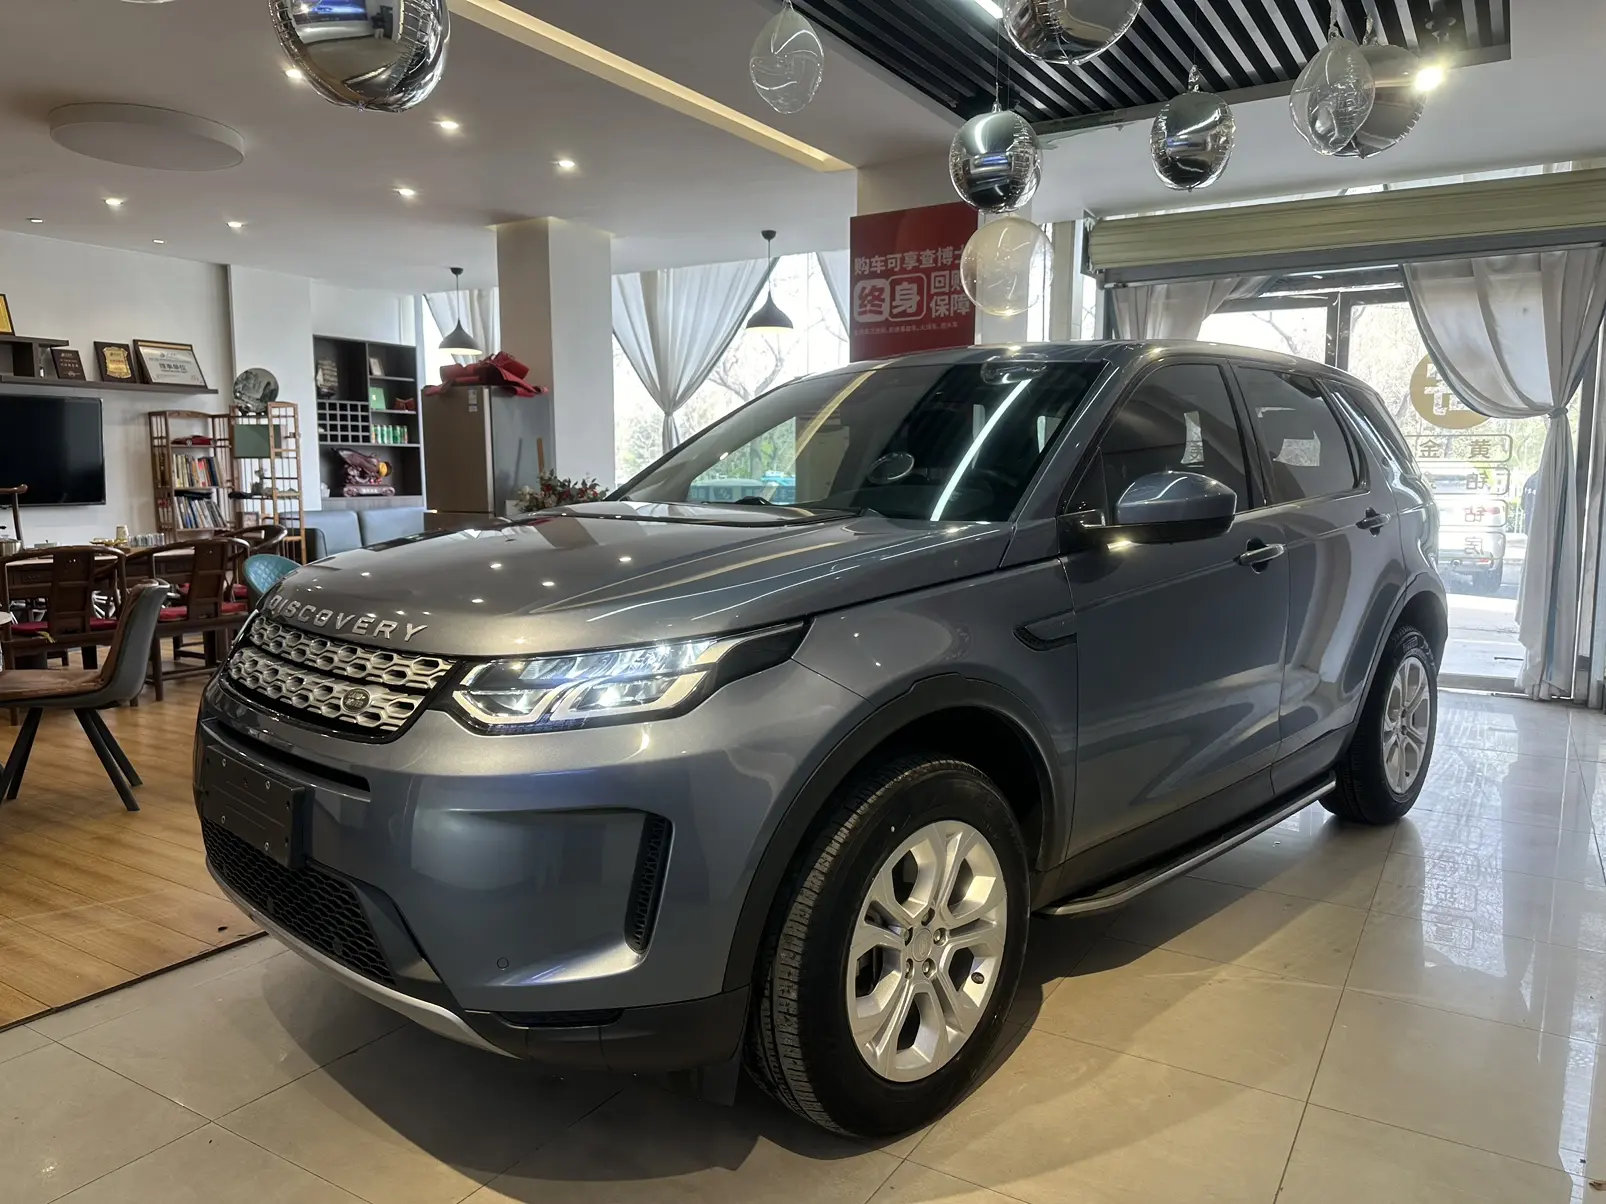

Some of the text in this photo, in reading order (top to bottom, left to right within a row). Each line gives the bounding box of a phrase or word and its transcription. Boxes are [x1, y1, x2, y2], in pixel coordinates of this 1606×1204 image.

[857, 280, 921, 317] 终身
[930, 294, 970, 318] 保障
[268, 594, 429, 642] DISCOVERY
